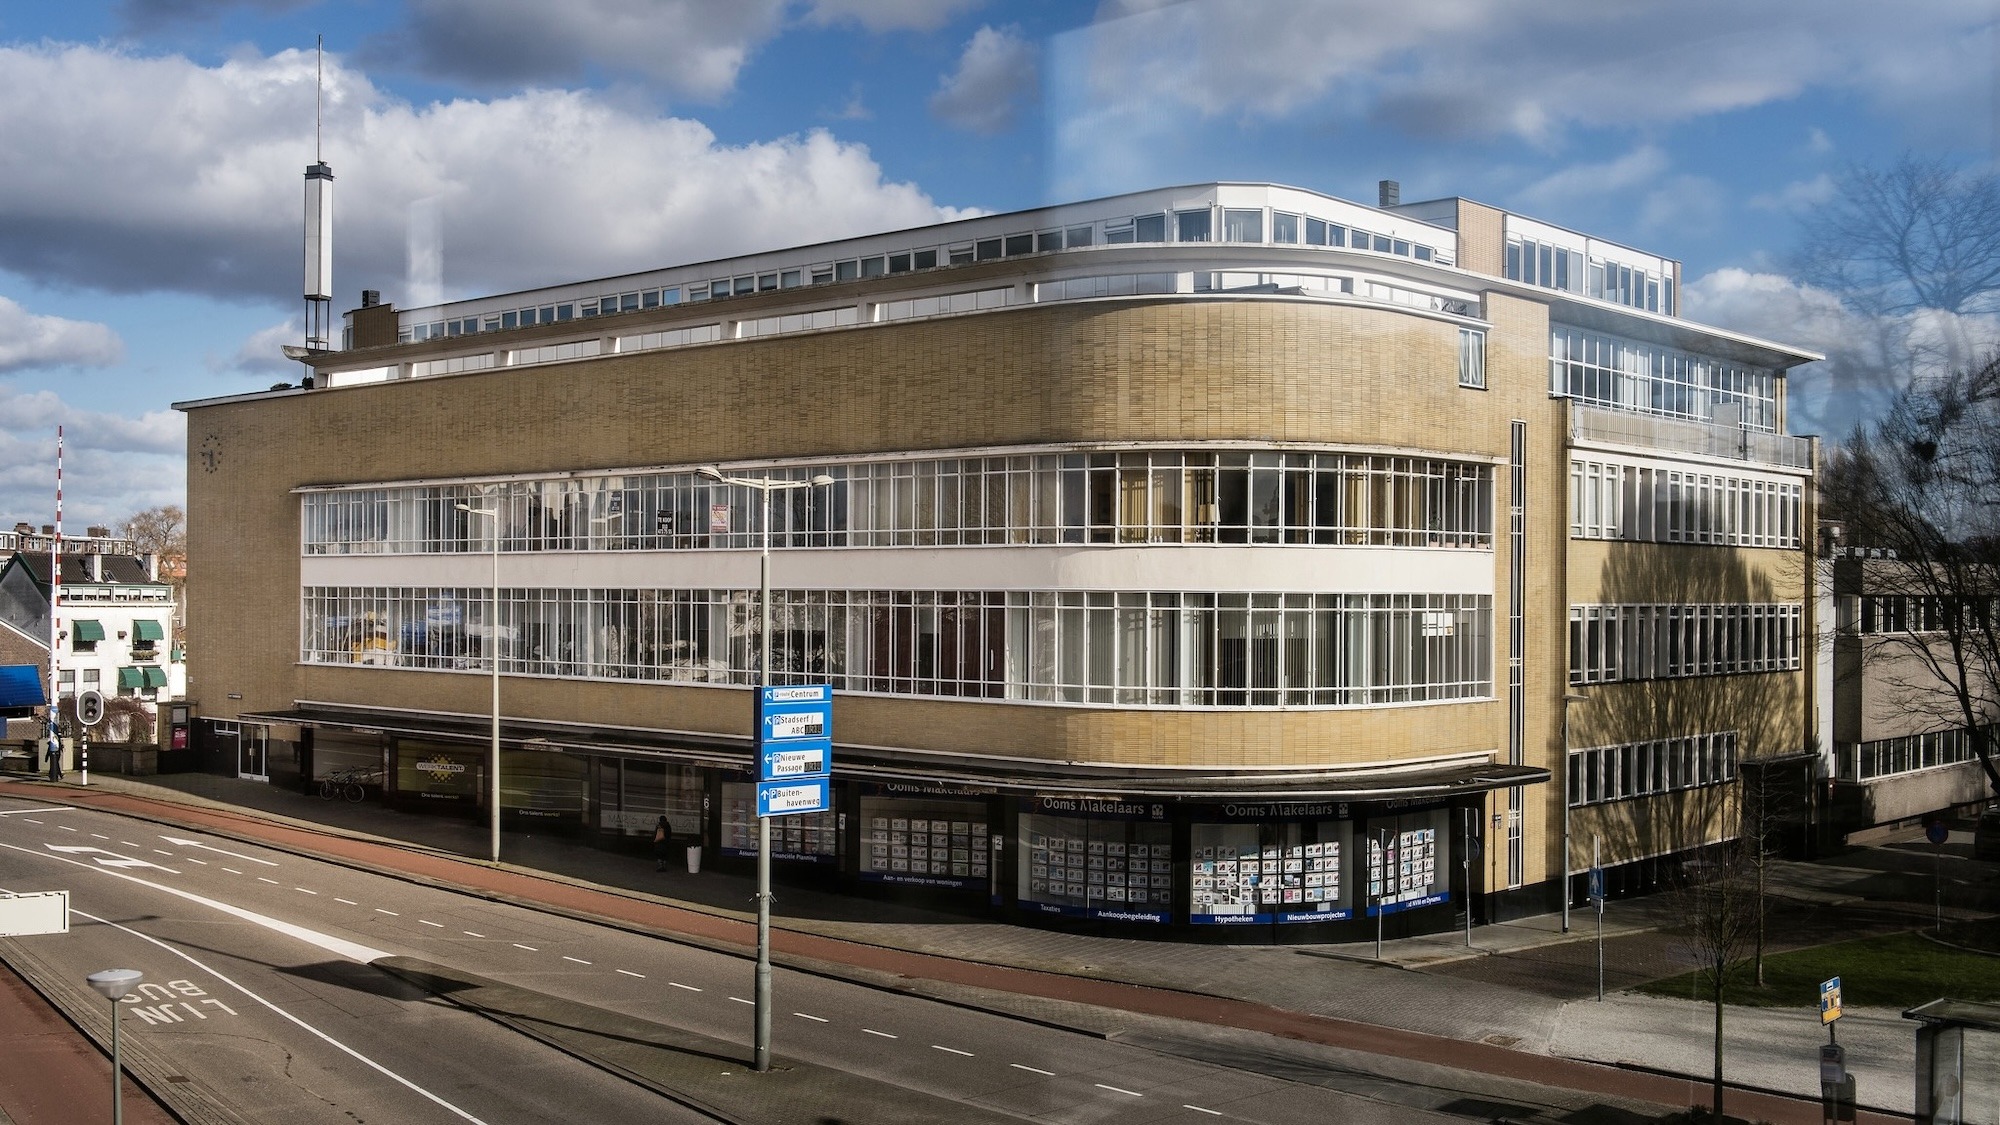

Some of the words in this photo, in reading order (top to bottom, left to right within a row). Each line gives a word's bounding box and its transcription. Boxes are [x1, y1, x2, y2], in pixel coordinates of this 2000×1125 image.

[791, 690, 819, 698] Centrum
[781, 715, 809, 724] Stadserf
[791, 726, 804, 735] ABC
[780, 754, 806, 762] Nieuwe
[777, 764, 803, 773] Passage
[778, 790, 803, 798] Buiten-
[703, 797, 710, 809] 6
[786, 798, 820, 807] havenweg
[1043, 797, 1076, 811] Ooms
[1080, 800, 1145, 815] Makelaars
[1225, 804, 1265, 816] Ooms
[1270, 803, 1333, 816] Makelaars
[904, 877, 925, 885] verkoop
[936, 879, 962, 887] woningen
[1097, 910, 1161, 922] Aankoopbegeleiding
[1214, 915, 1254, 923] Hypotheken
[1287, 911, 1346, 921] Nieuwbouwprojecten
[130, 999, 238, 1025] LIJN
